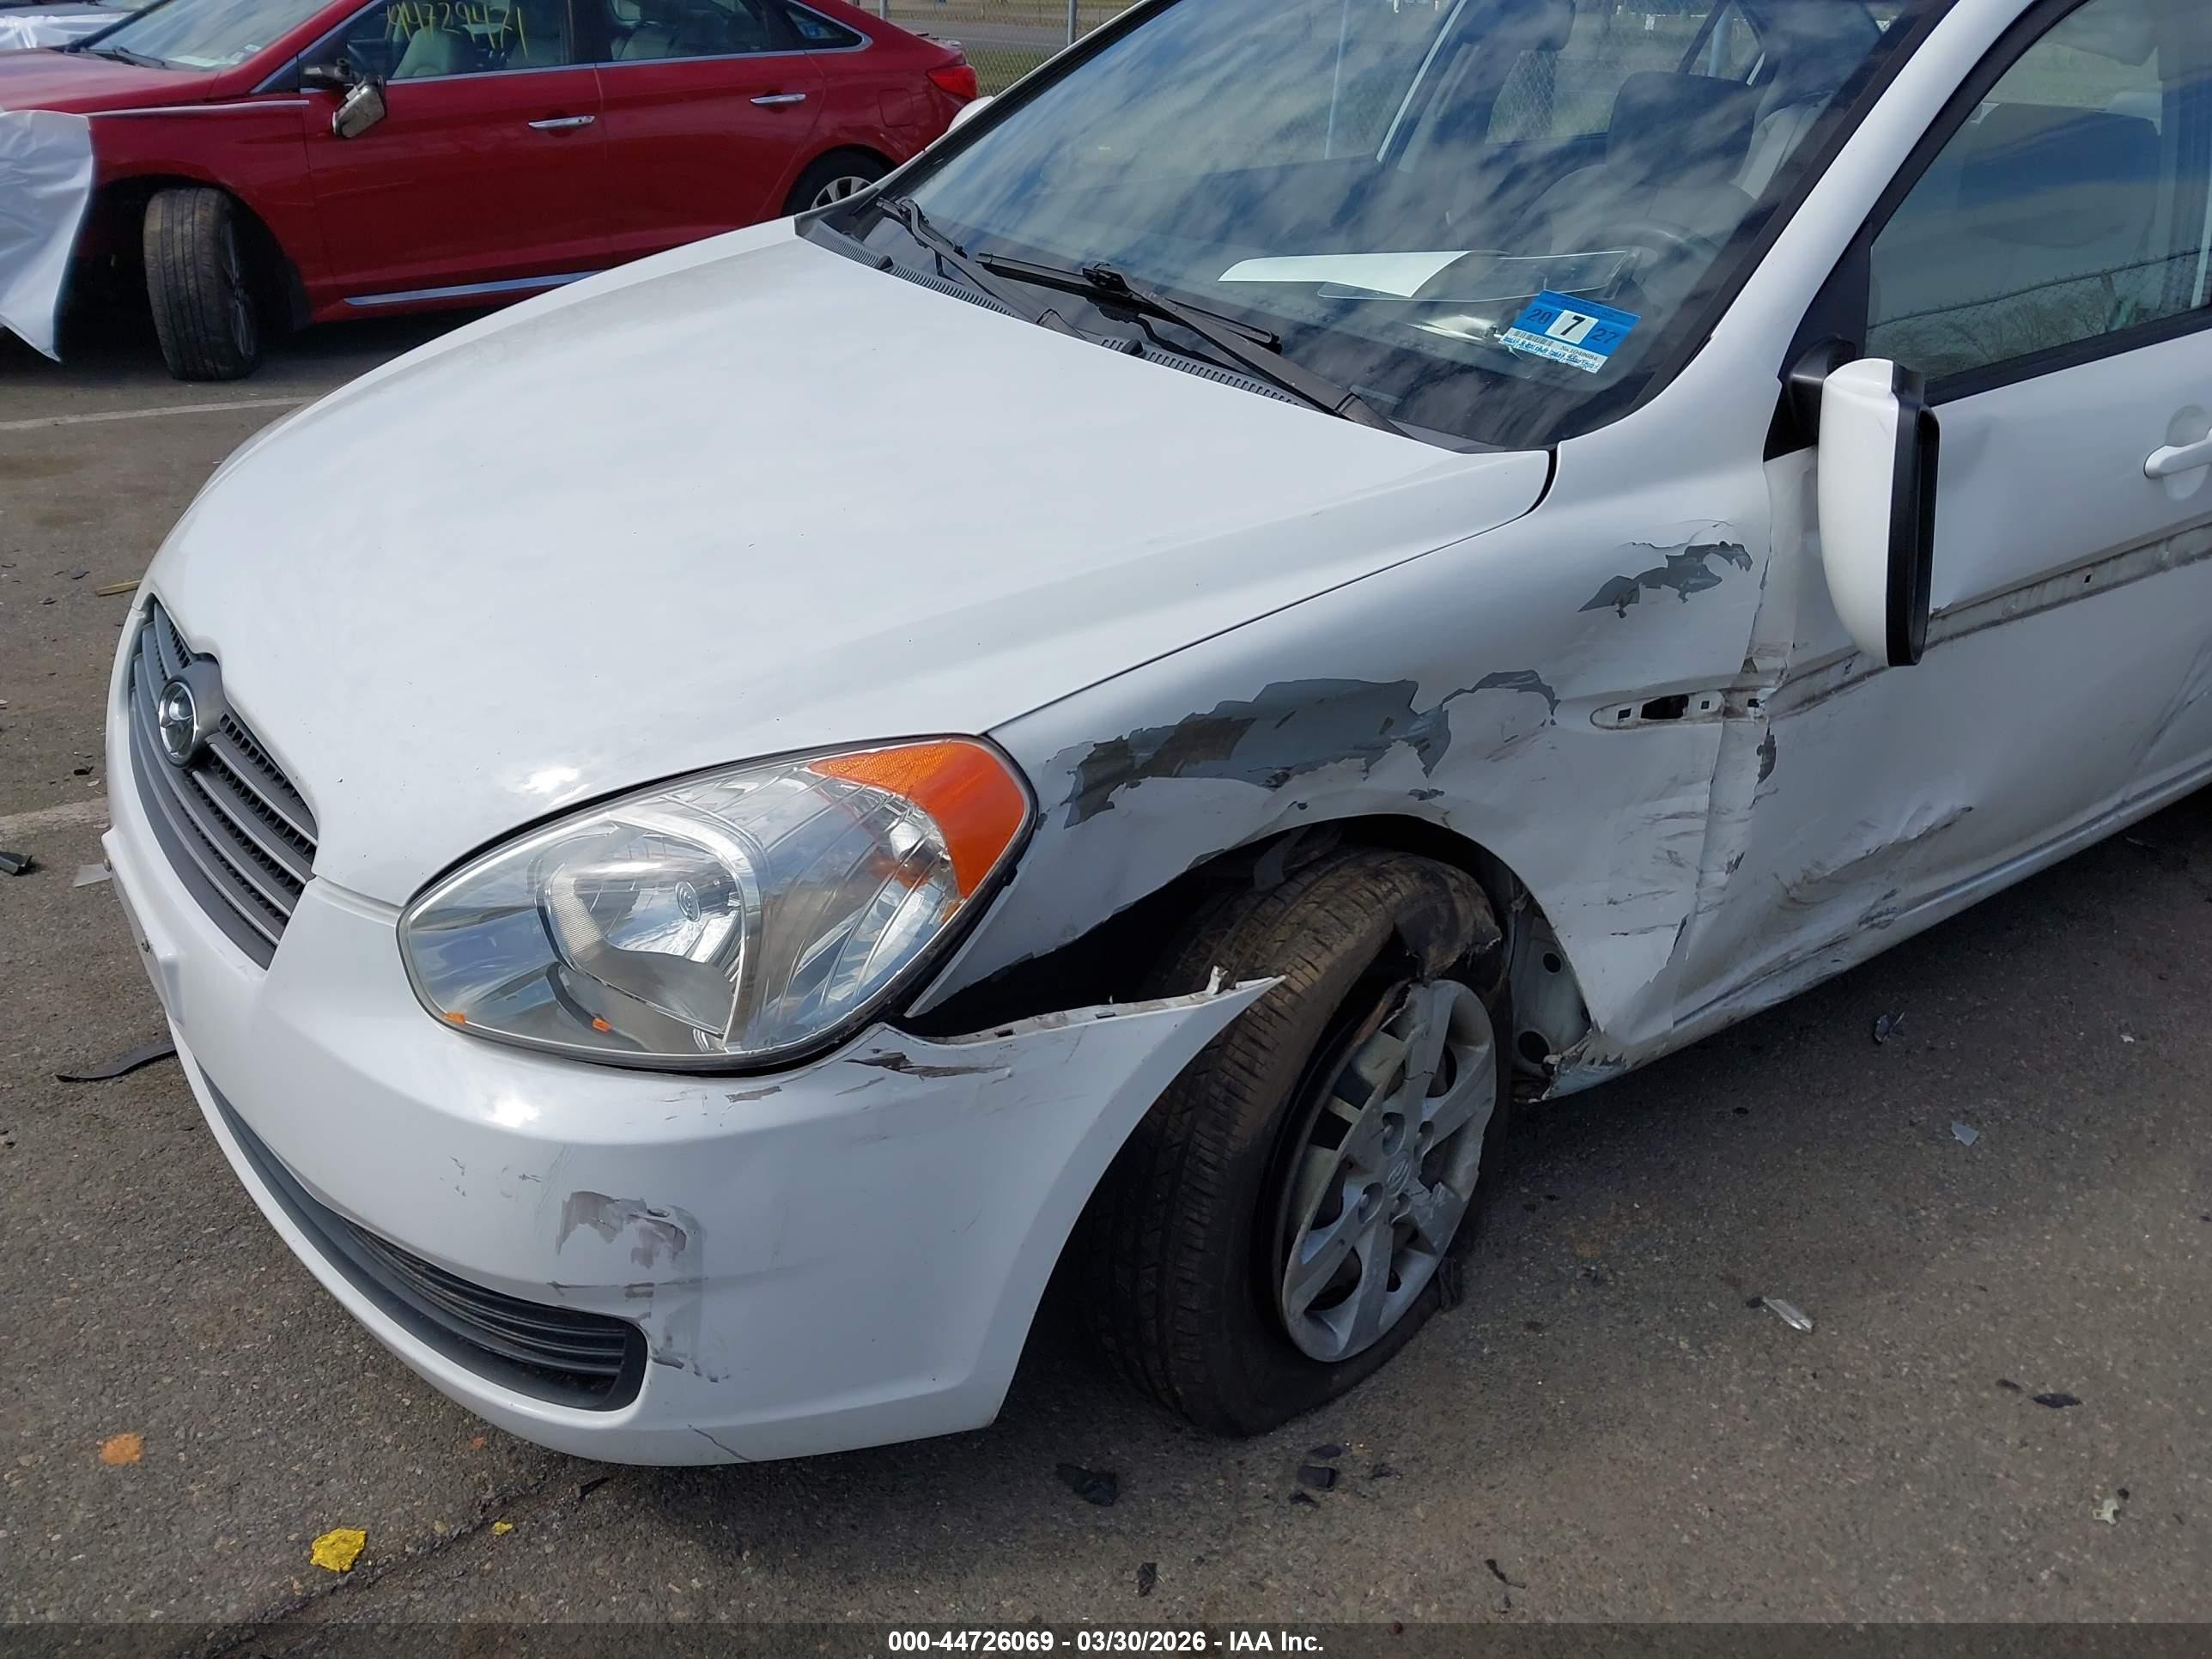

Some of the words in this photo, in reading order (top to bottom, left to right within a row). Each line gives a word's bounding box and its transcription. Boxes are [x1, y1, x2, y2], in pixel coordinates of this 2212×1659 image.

[1526, 308, 1553, 325] 20
[1560, 315, 1586, 336] 7
[1590, 328, 1621, 344] 27
